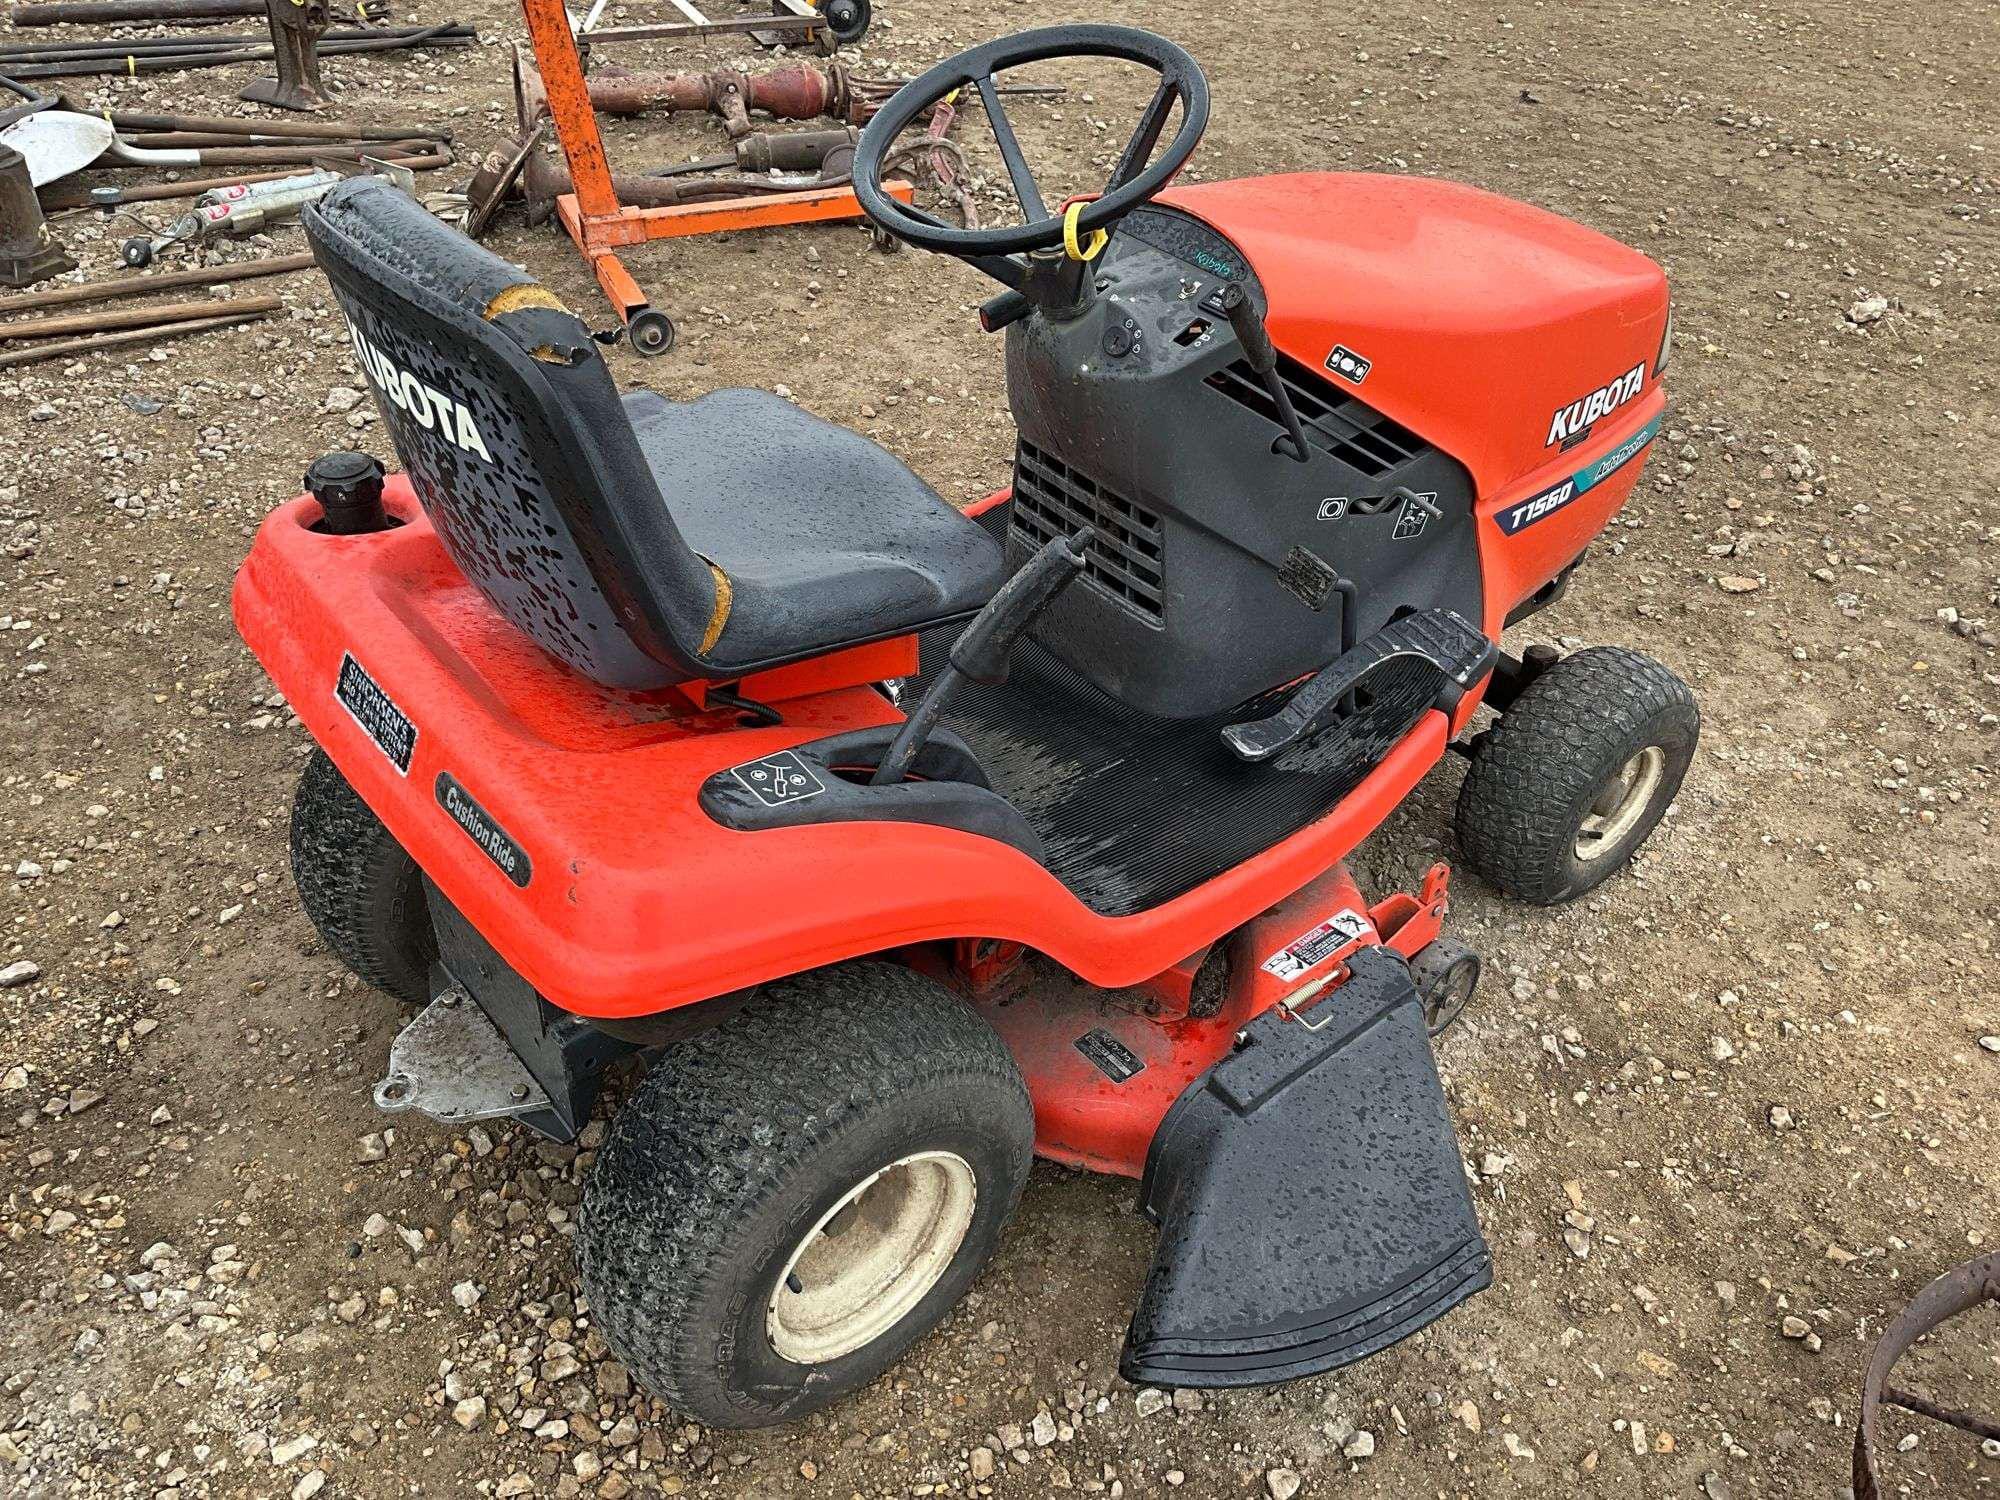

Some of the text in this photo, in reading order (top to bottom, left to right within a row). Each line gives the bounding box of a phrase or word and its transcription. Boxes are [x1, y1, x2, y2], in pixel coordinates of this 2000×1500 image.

[1195, 251, 1231, 276] Kubota
[1546, 362, 1646, 446] KUBOTA
[1511, 481, 1575, 530] T1560
[445, 787, 516, 873] Cushion Ride
